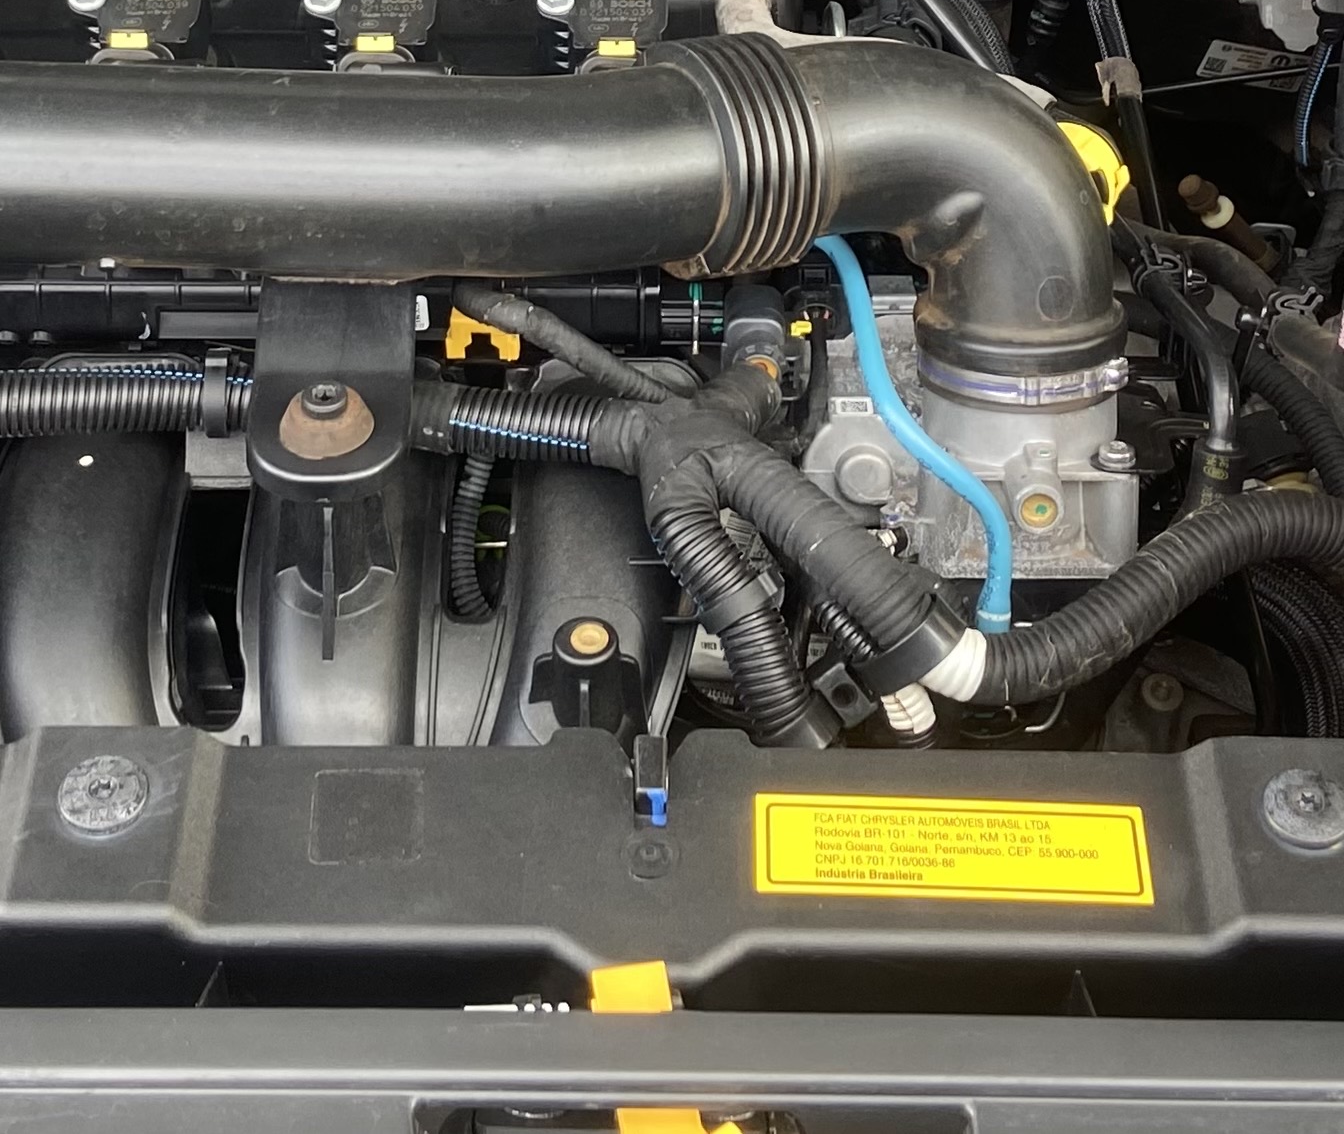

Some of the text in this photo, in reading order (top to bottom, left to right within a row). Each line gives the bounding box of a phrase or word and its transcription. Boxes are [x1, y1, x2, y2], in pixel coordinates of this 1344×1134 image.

[610, 0, 652, 8] BOSCH
[814, 812, 1051, 830] FCA FIAT CHRYSLER AUTOMÓVEIS BRASIL LTDA
[814, 827, 860, 838] Rodovia
[864, 827, 906, 839] BR-101
[917, 830, 953, 842] Norte,
[979, 832, 999, 843] KM
[1004, 833, 1017, 843] 13
[1019, 836, 1035, 844] ao
[814, 841, 842, 851] Nova
[934, 843, 1005, 856] Pernambuco,
[1038, 848, 1100, 859] 55.900-000
[815, 853, 846, 865] CNPJ
[815, 867, 923, 881] Indústria Brasileira
